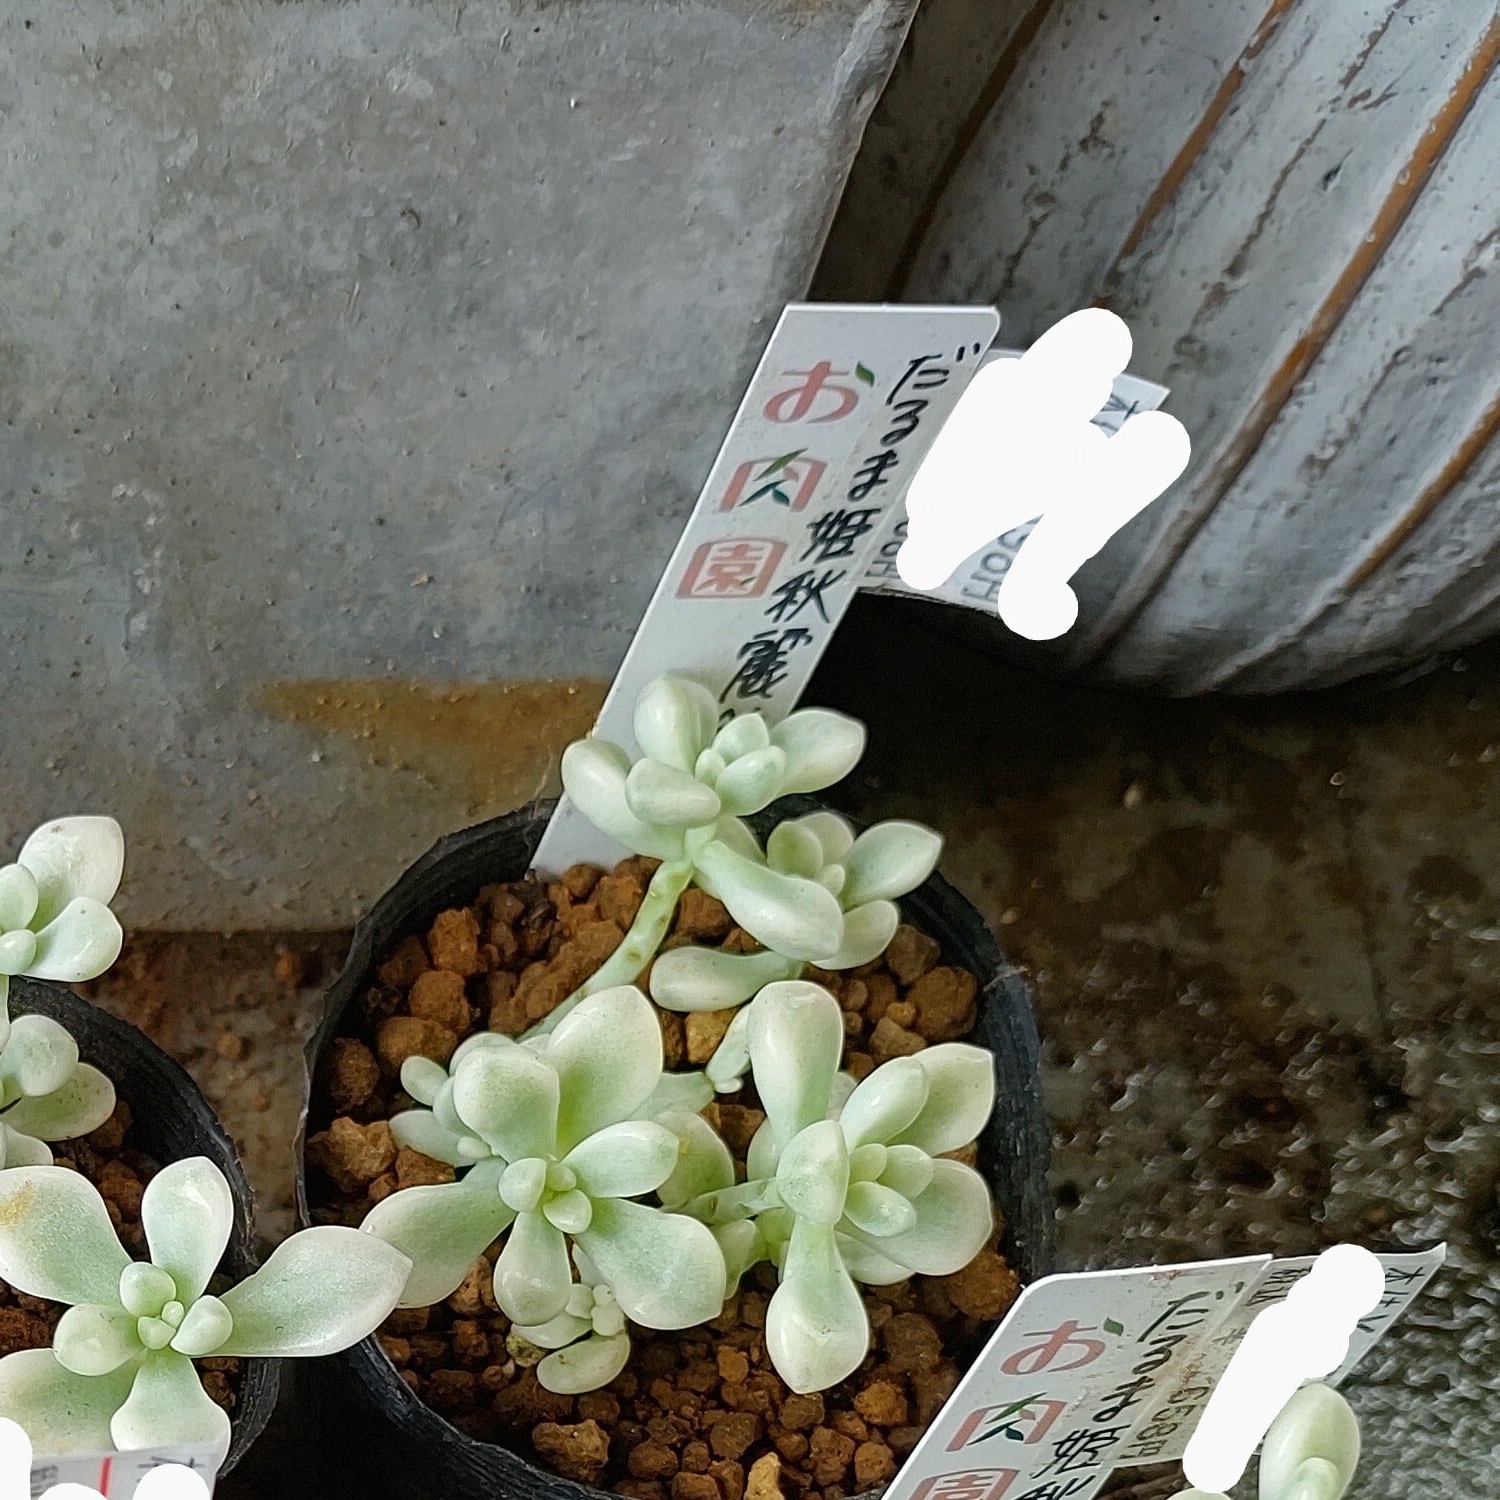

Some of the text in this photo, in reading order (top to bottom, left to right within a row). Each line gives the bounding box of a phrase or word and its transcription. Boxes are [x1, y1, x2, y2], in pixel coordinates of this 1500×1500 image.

[675, 360, 874, 599] お肉園
[717, 341, 981, 730] だるま姫秋麗
